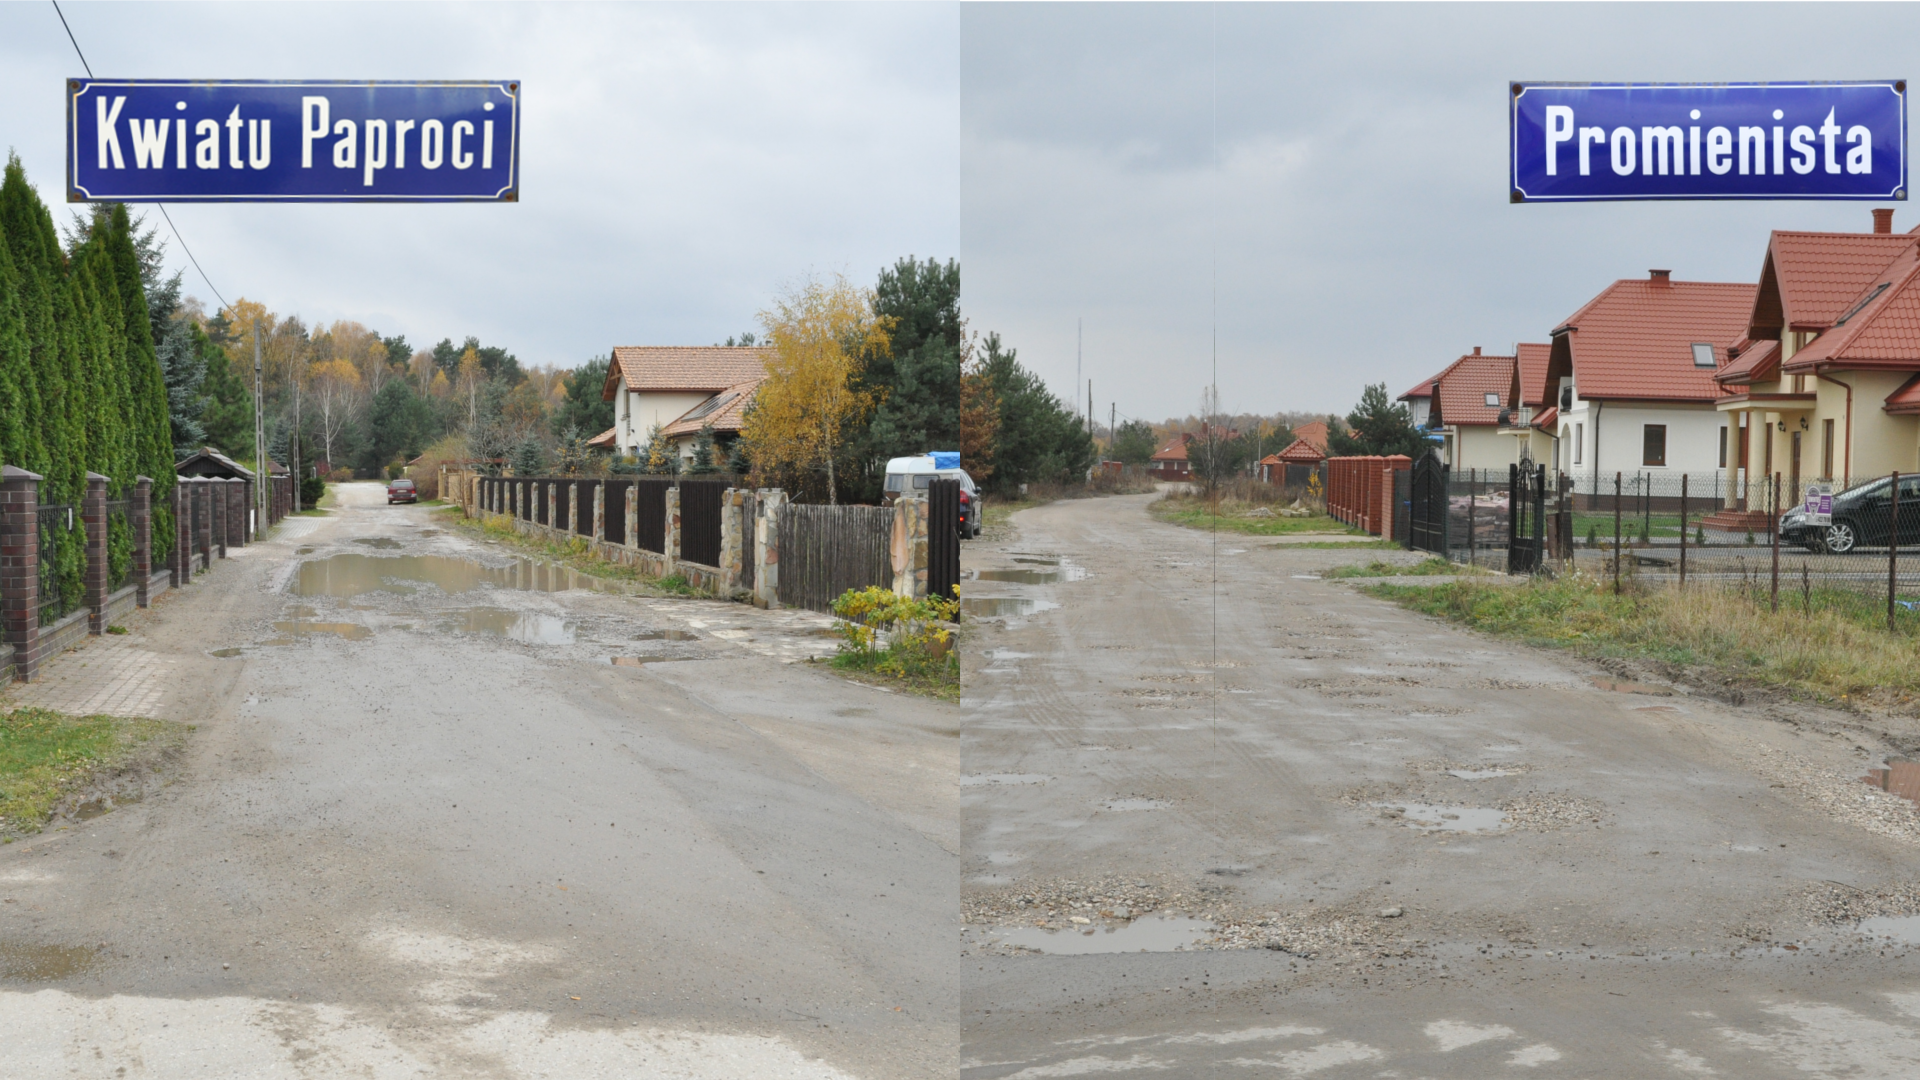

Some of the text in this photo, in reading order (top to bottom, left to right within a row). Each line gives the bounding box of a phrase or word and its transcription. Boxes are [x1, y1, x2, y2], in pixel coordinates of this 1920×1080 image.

[97, 96, 494, 187] Kwiatu Paproci
[1546, 105, 1872, 176] Promienista
